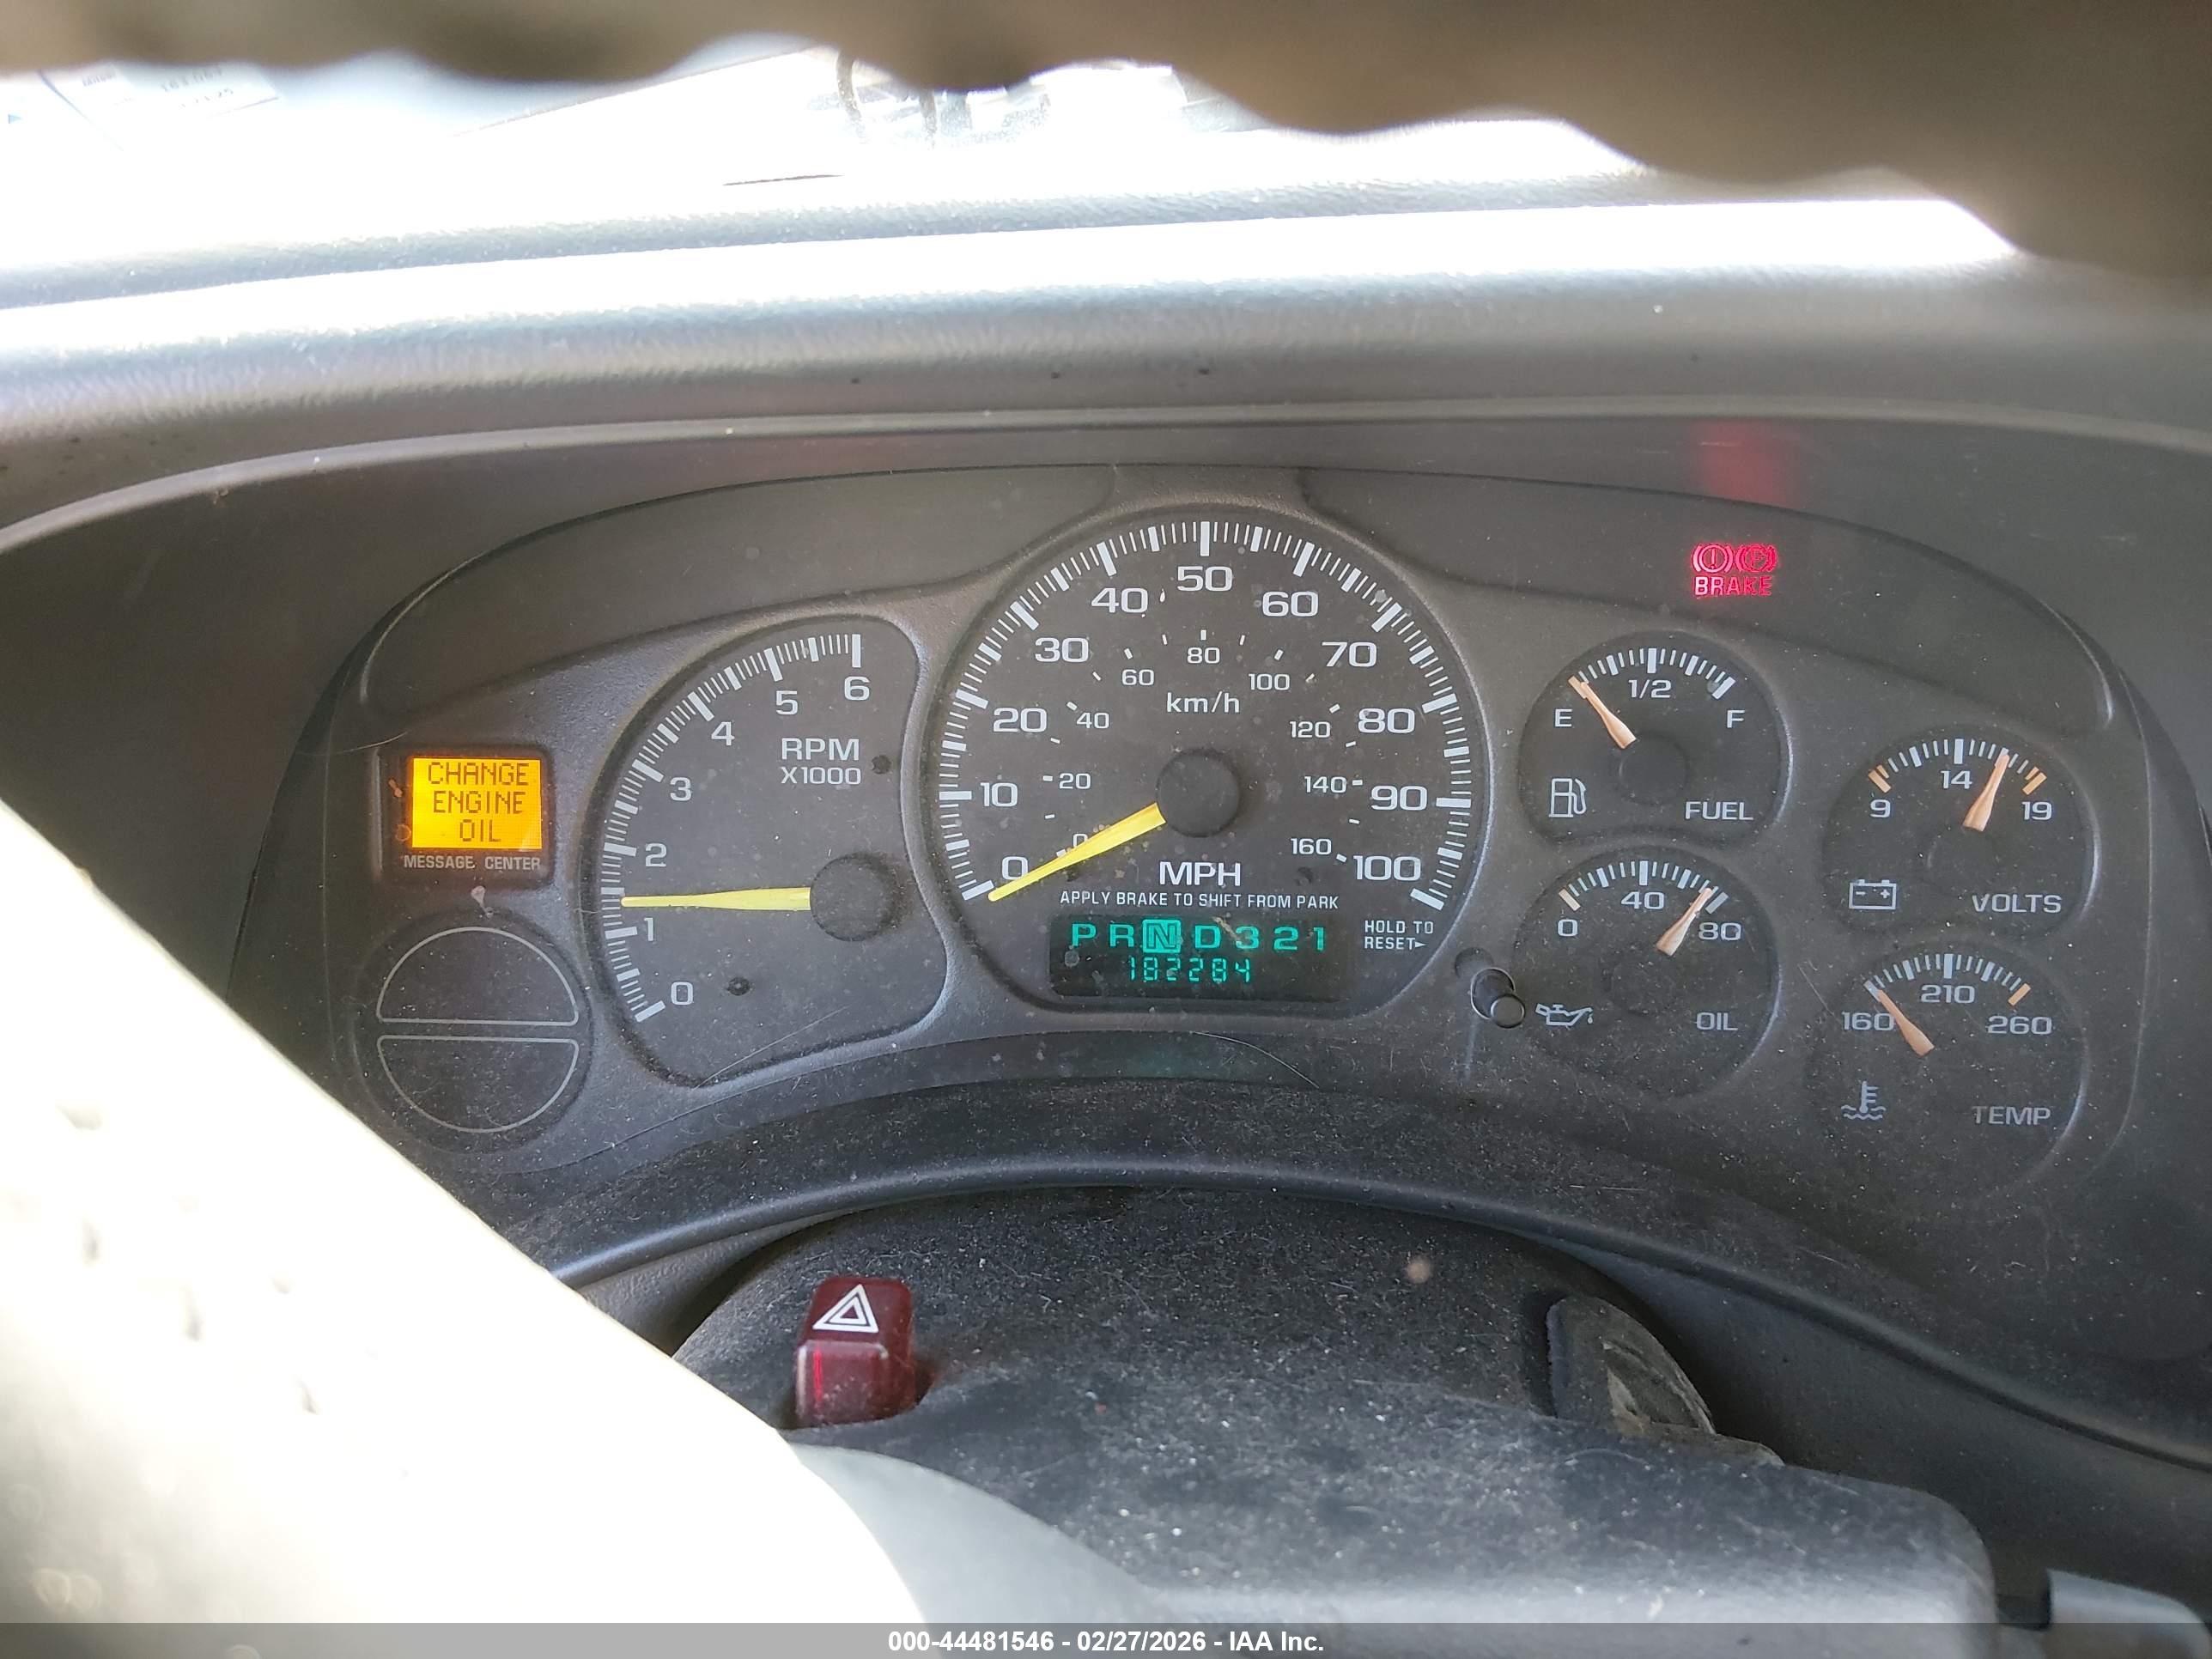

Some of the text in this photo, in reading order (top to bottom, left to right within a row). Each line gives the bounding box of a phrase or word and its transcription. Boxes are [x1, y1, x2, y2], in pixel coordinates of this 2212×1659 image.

[1177, 566, 1232, 592] 50
[1694, 576, 1772, 596] BRAKE
[1091, 587, 1148, 613] 40
[1262, 591, 1319, 617] 60
[1035, 637, 1089, 663] 30
[1187, 647, 1220, 664] 80
[1322, 641, 1377, 667] 70
[1121, 669, 1155, 686] 60
[1248, 673, 1291, 691] 100
[844, 676, 871, 701] 6
[1628, 679, 1672, 699] 1/2
[775, 690, 799, 715] 5
[1166, 690, 1240, 714] km/h
[993, 708, 1048, 732] 20
[1076, 712, 1110, 729] 40
[1358, 708, 1415, 733] 80
[1554, 708, 1573, 727] E
[1726, 709, 1746, 728] F
[711, 721, 736, 746] 4
[1290, 720, 1331, 738] 120
[781, 738, 860, 761] RPM
[428, 762, 529, 786] CHANGE
[780, 766, 862, 785] X1000
[1058, 773, 1091, 789] 20
[1304, 775, 1347, 793] 140
[1940, 770, 1972, 789] 14
[670, 777, 692, 801] 3
[980, 782, 1018, 807] 10
[1370, 786, 1428, 811] 90
[434, 790, 526, 814] ENGINE
[1685, 801, 1753, 820] FUEL
[1869, 799, 1891, 818] 9
[2021, 801, 2053, 821] 19
[459, 819, 501, 842] OIL
[645, 843, 667, 867] 2
[1290, 838, 1332, 855] 160
[404, 854, 541, 871] MESSAGE CENTER
[1001, 856, 1029, 881] 0
[1353, 855, 1421, 881] 100
[1159, 861, 1241, 886] MPH
[1060, 891, 1339, 909] APPLY BRAKE TO SHIFT FROM PARK
[1620, 891, 1665, 909] 40
[1972, 894, 2062, 913] VOLTS
[643, 917, 654, 941] 1
[1072, 922, 1325, 951] P R N D 3 2 1
[1364, 920, 1434, 934] HOLD TO
[1557, 919, 1578, 937] 0
[1698, 922, 1741, 941] 80
[1364, 936, 1415, 951] RESET
[1127, 957, 1251, 983] 182284
[671, 981, 694, 1006] 0
[1920, 984, 1975, 1004] 210
[1696, 1012, 1738, 1031] OIL
[1841, 1012, 1894, 1031] 160
[1987, 1016, 2053, 1036] 260
[1972, 1106, 2051, 1126] TEMP
